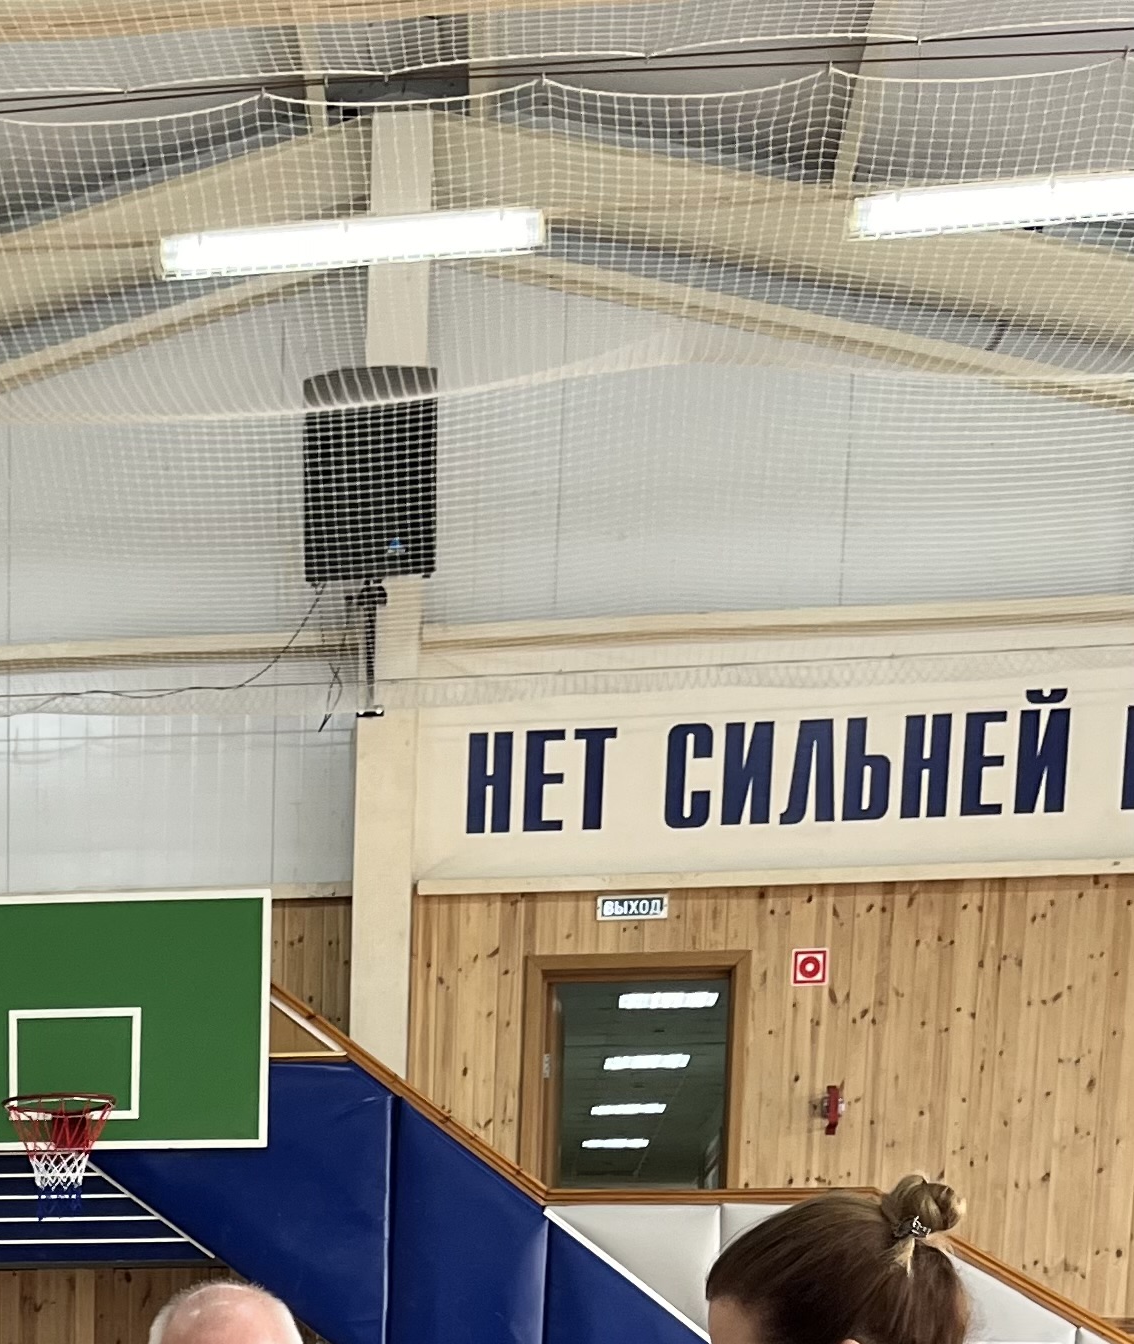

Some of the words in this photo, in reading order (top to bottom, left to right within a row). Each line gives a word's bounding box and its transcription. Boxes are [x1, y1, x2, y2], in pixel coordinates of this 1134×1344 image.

[465, 726, 618, 835] НЕТ
[663, 688, 1072, 830] СИЛЬНЕЙ
[602, 899, 661, 916] ВЫХОД
